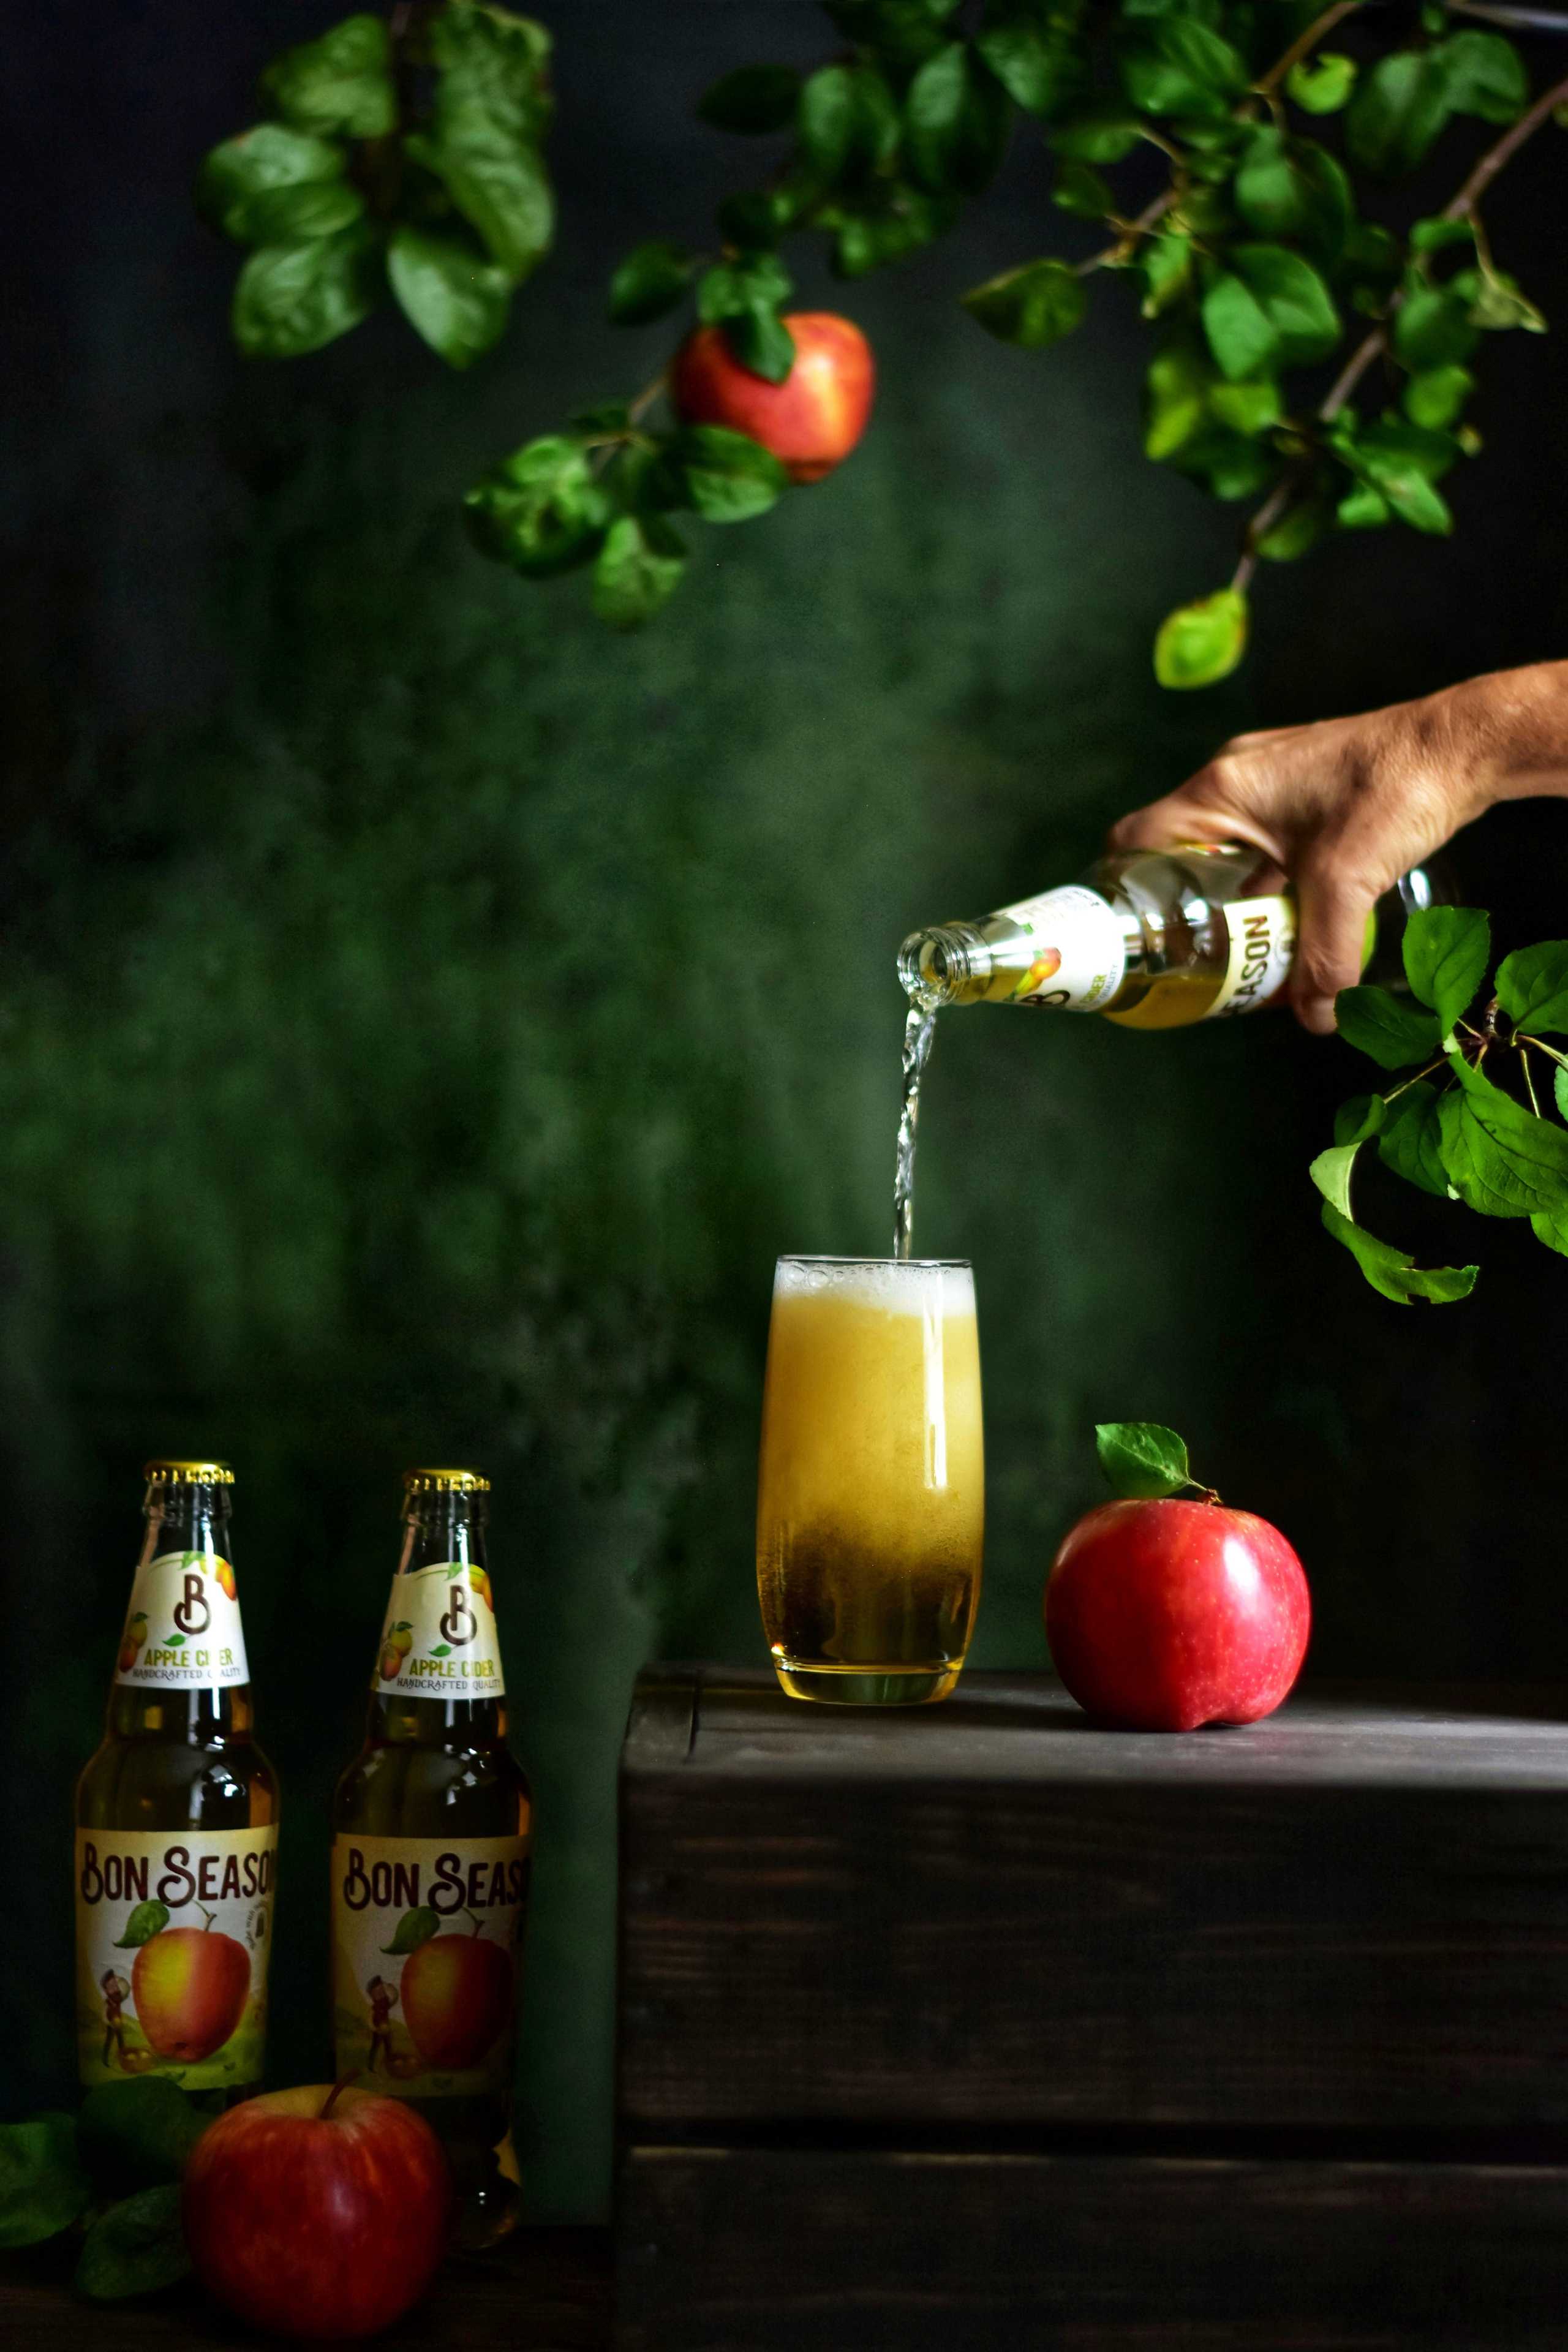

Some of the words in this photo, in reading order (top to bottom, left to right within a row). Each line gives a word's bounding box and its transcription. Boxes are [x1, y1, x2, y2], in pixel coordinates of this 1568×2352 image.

[174, 1574, 211, 1635] B
[440, 1585, 477, 1645] B
[132, 1668, 203, 1681] HANDCRAFTED
[144, 1649, 190, 1667] APPLE
[196, 1648, 233, 1667] CIER
[409, 1659, 456, 1678] APPLE
[461, 1659, 495, 1677] CIDER
[398, 1678, 467, 1691] HANDCRAFTED
[81, 1842, 149, 1905] BON
[344, 1848, 420, 1911] BON
